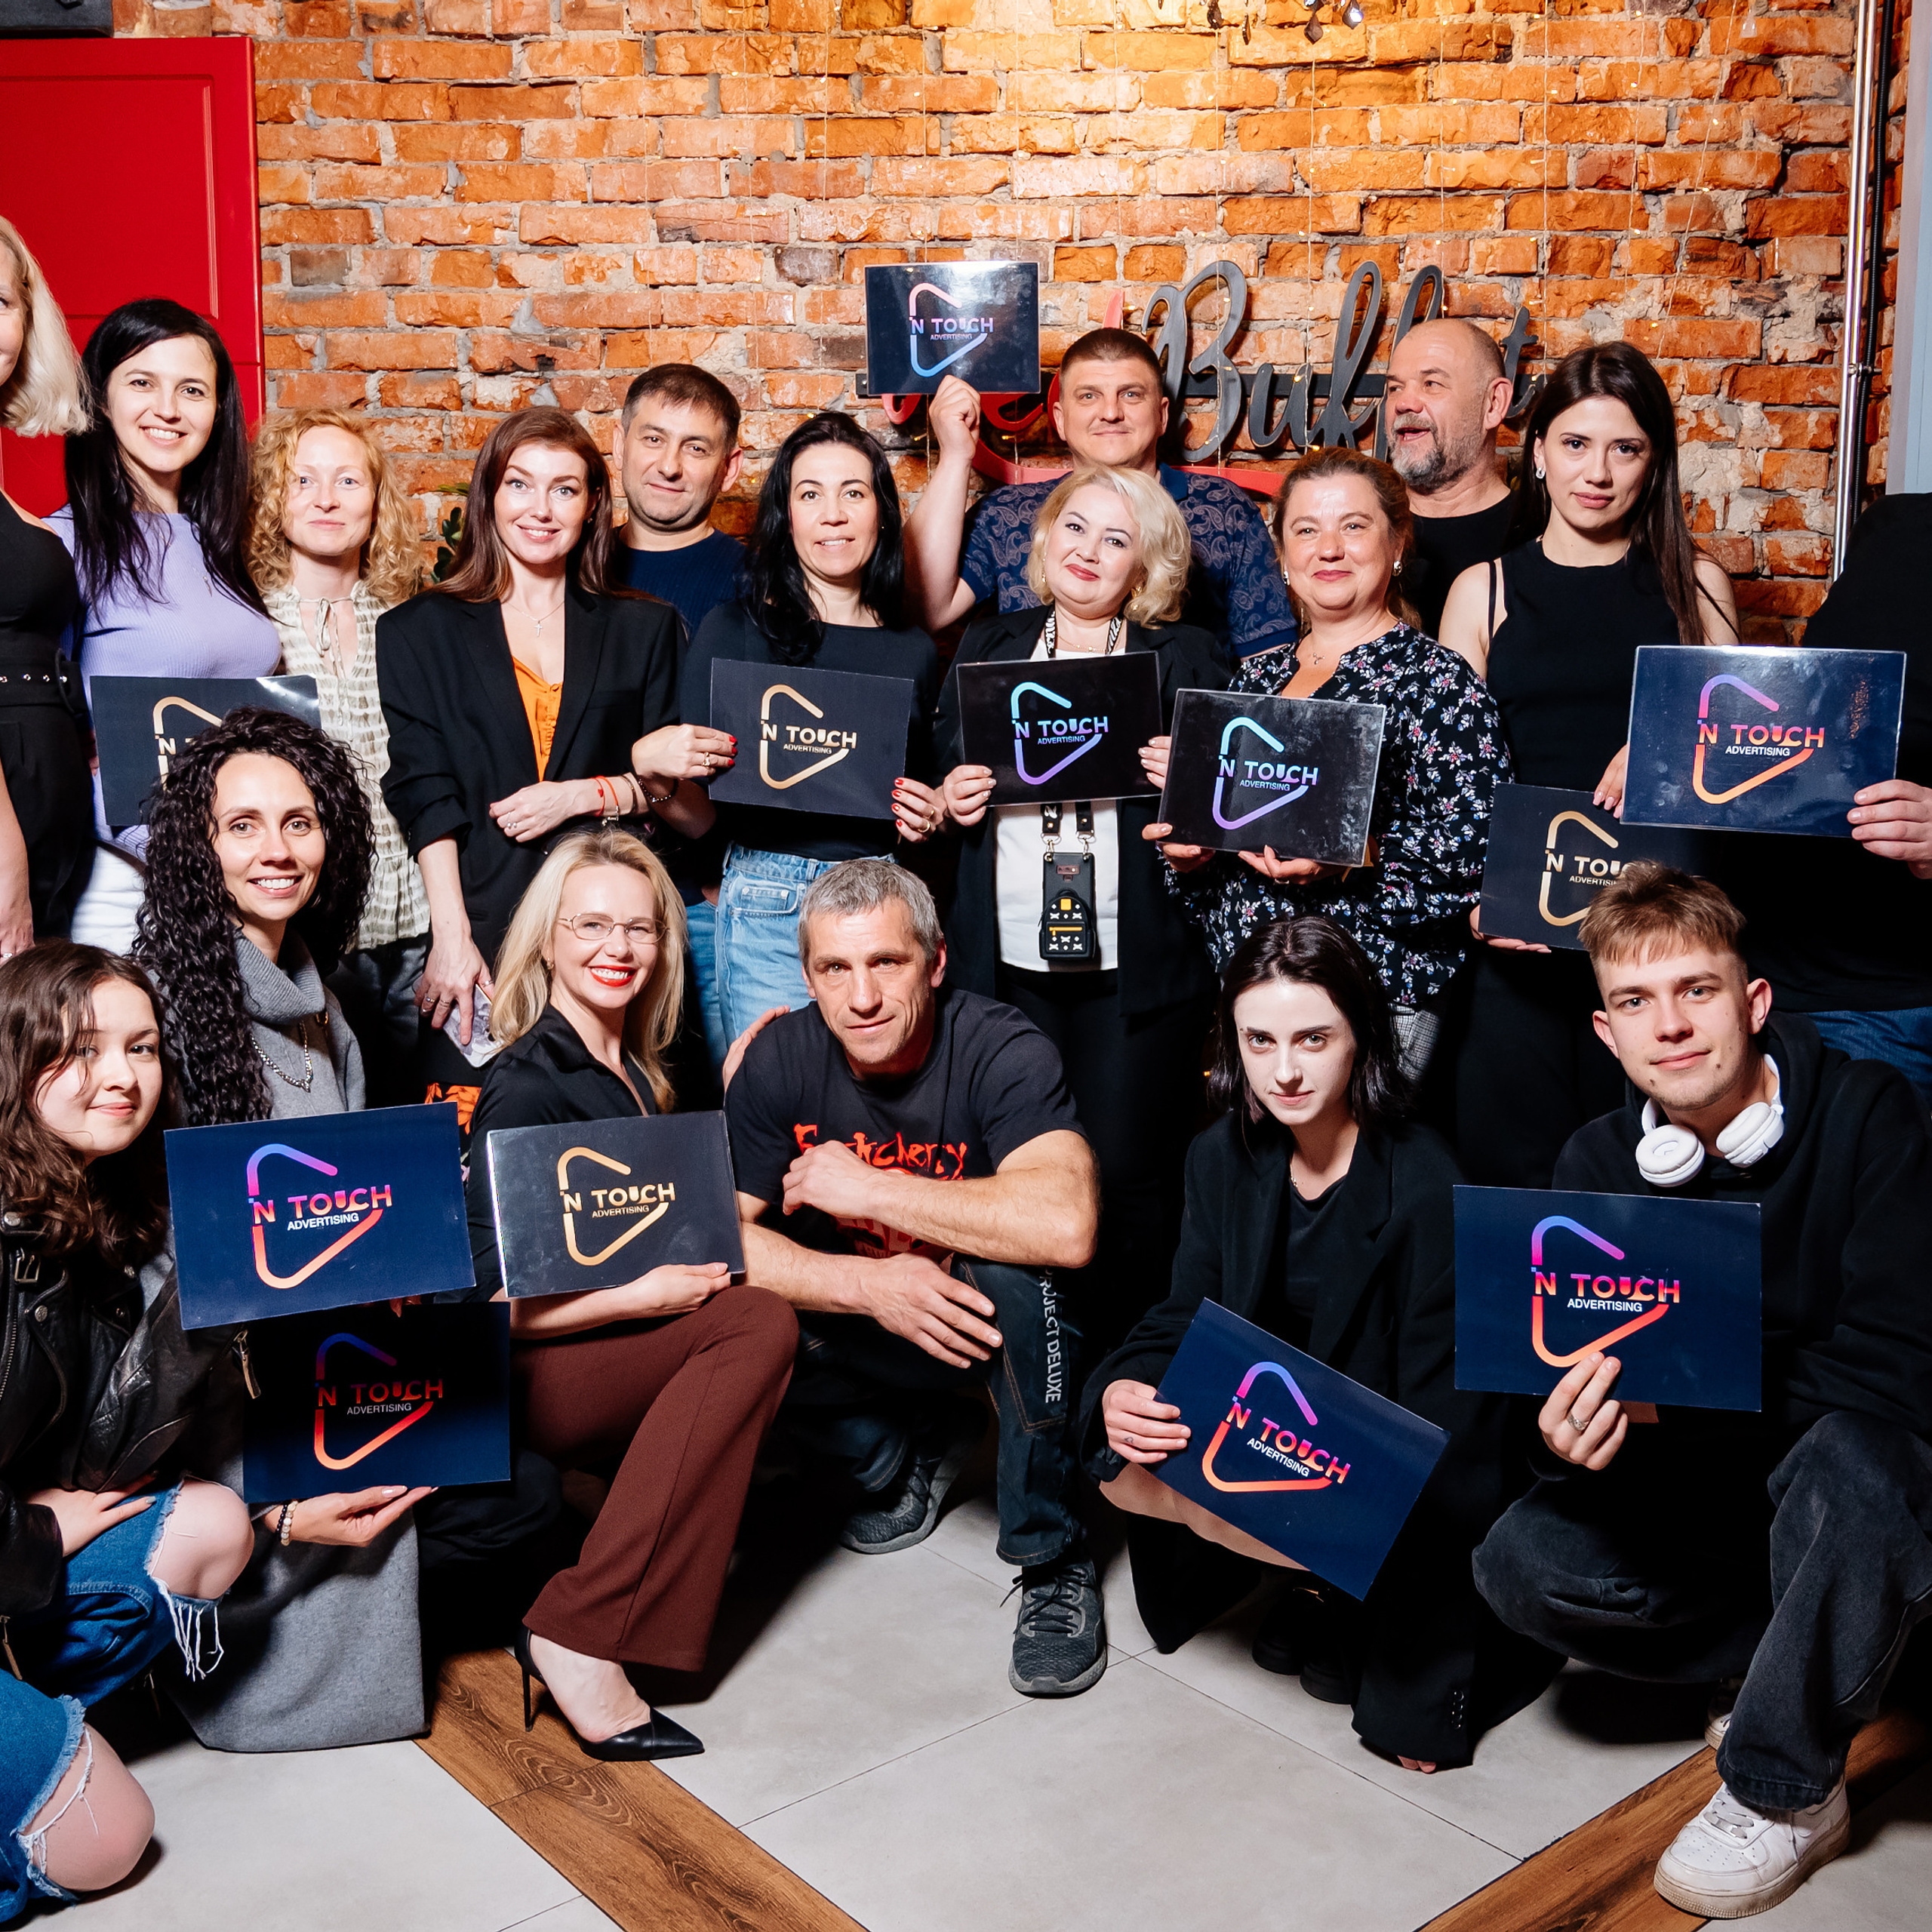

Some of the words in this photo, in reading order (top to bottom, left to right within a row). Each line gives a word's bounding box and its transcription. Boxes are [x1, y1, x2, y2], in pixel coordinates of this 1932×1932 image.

[931, 318, 993, 333] TOUCH
[786, 725, 857, 749] TOUCH
[1038, 716, 1108, 737] TOUCH
[1730, 724, 1824, 748] TOUCH
[783, 744, 832, 754] ADVERTISING
[1038, 736, 1085, 745] ADVERTISING
[1725, 746, 1789, 756] ADVERTISING
[1244, 761, 1318, 785] TOUCH
[1240, 780, 1290, 791] ADVERTISING
[288, 1185, 392, 1219] TOUCH
[591, 1183, 675, 1208] TOUCH
[288, 1213, 359, 1231] ADVERTISING
[592, 1204, 649, 1218] ADVERTISING
[1571, 1273, 1679, 1303] TOUCH
[1567, 1299, 1642, 1312] ADVERTISING
[1045, 1338, 1063, 1404] DELUXE
[351, 1379, 442, 1404] TOUCH
[347, 1403, 411, 1415] ADVERTISING
[1247, 1438, 1309, 1477] ADVERTISING
[1260, 1417, 1351, 1484] TOUCH
